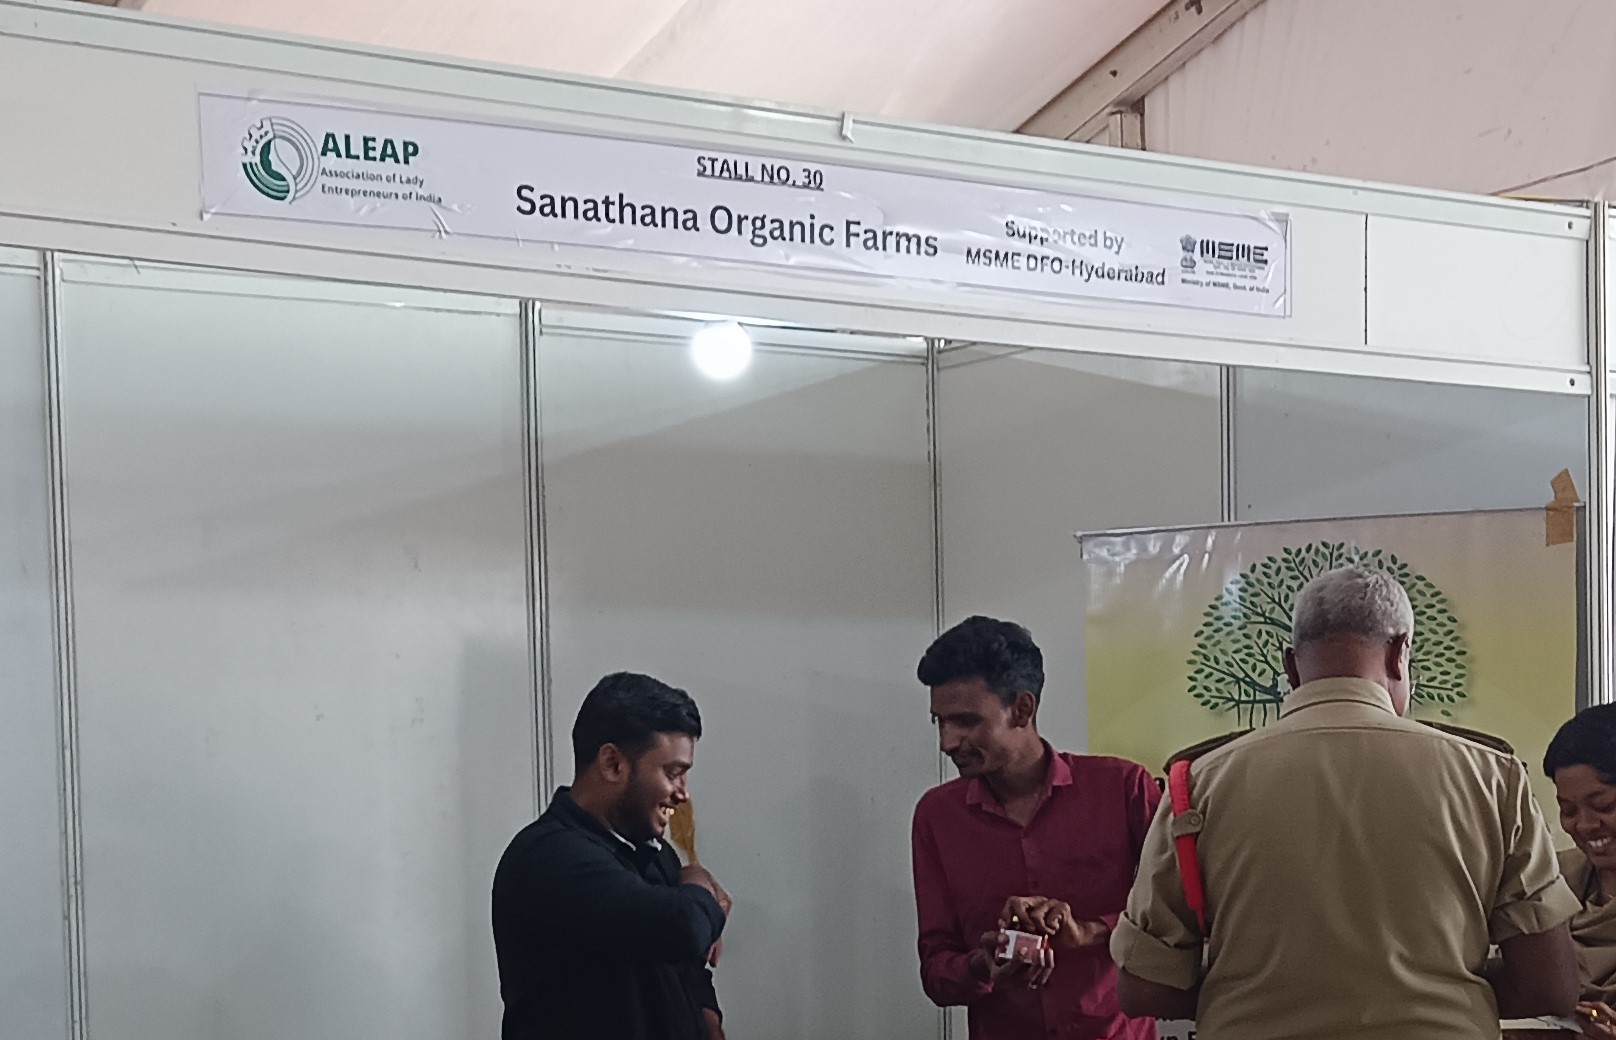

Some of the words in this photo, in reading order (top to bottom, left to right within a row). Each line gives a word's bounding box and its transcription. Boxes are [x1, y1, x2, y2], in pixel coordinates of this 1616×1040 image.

[320, 132, 420, 165] ALEAP
[320, 166, 383, 181] Association
[385, 172, 397, 183] of
[399, 173, 425, 188] Lady
[696, 155, 754, 181] STALL
[802, 168, 825, 191] 30
[321, 183, 399, 200] Entrepreneurs
[401, 191, 413, 201] of
[415, 192, 443, 204] India
[516, 184, 700, 232] Sanathana
[709, 205, 835, 248] Organic
[844, 217, 940, 258] Farms
[1004, 219, 1099, 248] Supported
[1103, 230, 1125, 256] by
[965, 247, 1022, 271] MSME
[1026, 253, 1166, 286] DFO-Hyderabad
